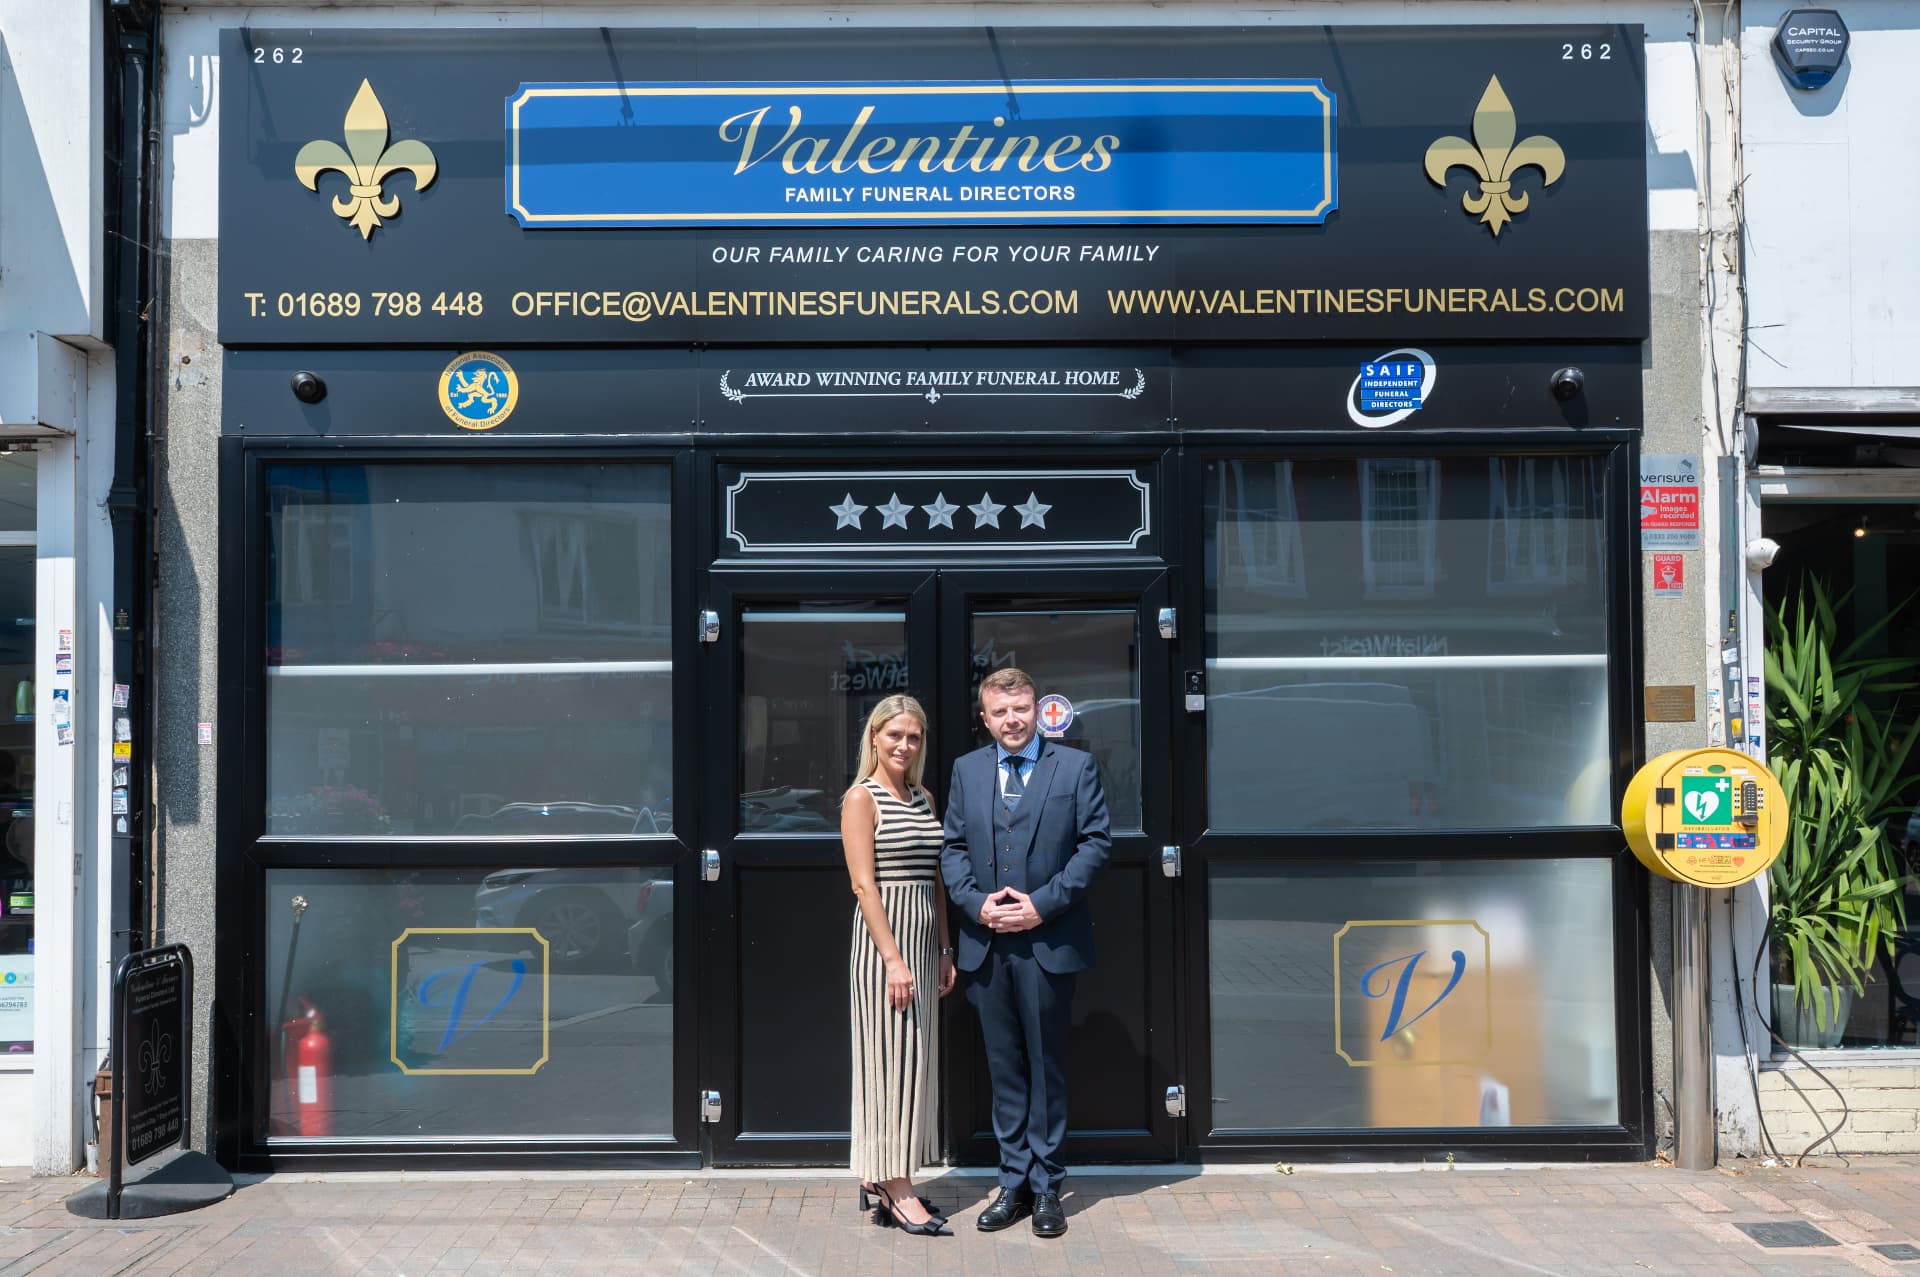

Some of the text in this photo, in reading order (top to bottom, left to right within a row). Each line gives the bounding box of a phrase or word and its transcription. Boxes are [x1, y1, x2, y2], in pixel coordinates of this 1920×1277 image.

[1787, 27, 1841, 37] CAPITAL
[254, 47, 303, 64] 262
[1562, 43, 1611, 60] 262
[718, 104, 1120, 176] Valentines
[785, 185, 1075, 203] FAMILY FUNERAL DIRECTORS
[712, 245, 1160, 264] OUR FAMILY CARING FOR YOUR FAMILY
[243, 291, 484, 317] T: 01689 798 448
[511, 290, 1078, 321] OFFICE@VALENTINESFUNERALS.COM
[1107, 287, 1624, 315] WWW.VALENTINESFUNERALS.COM
[744, 370, 1120, 387] AWARD WINNING FAMILY FUNERAL HOME
[1366, 364, 1415, 376] SAIF
[1640, 473, 1695, 484] verisure
[1641, 488, 1696, 504] Alarm
[1659, 504, 1688, 514] Images
[1659, 512, 1695, 520] recorded
